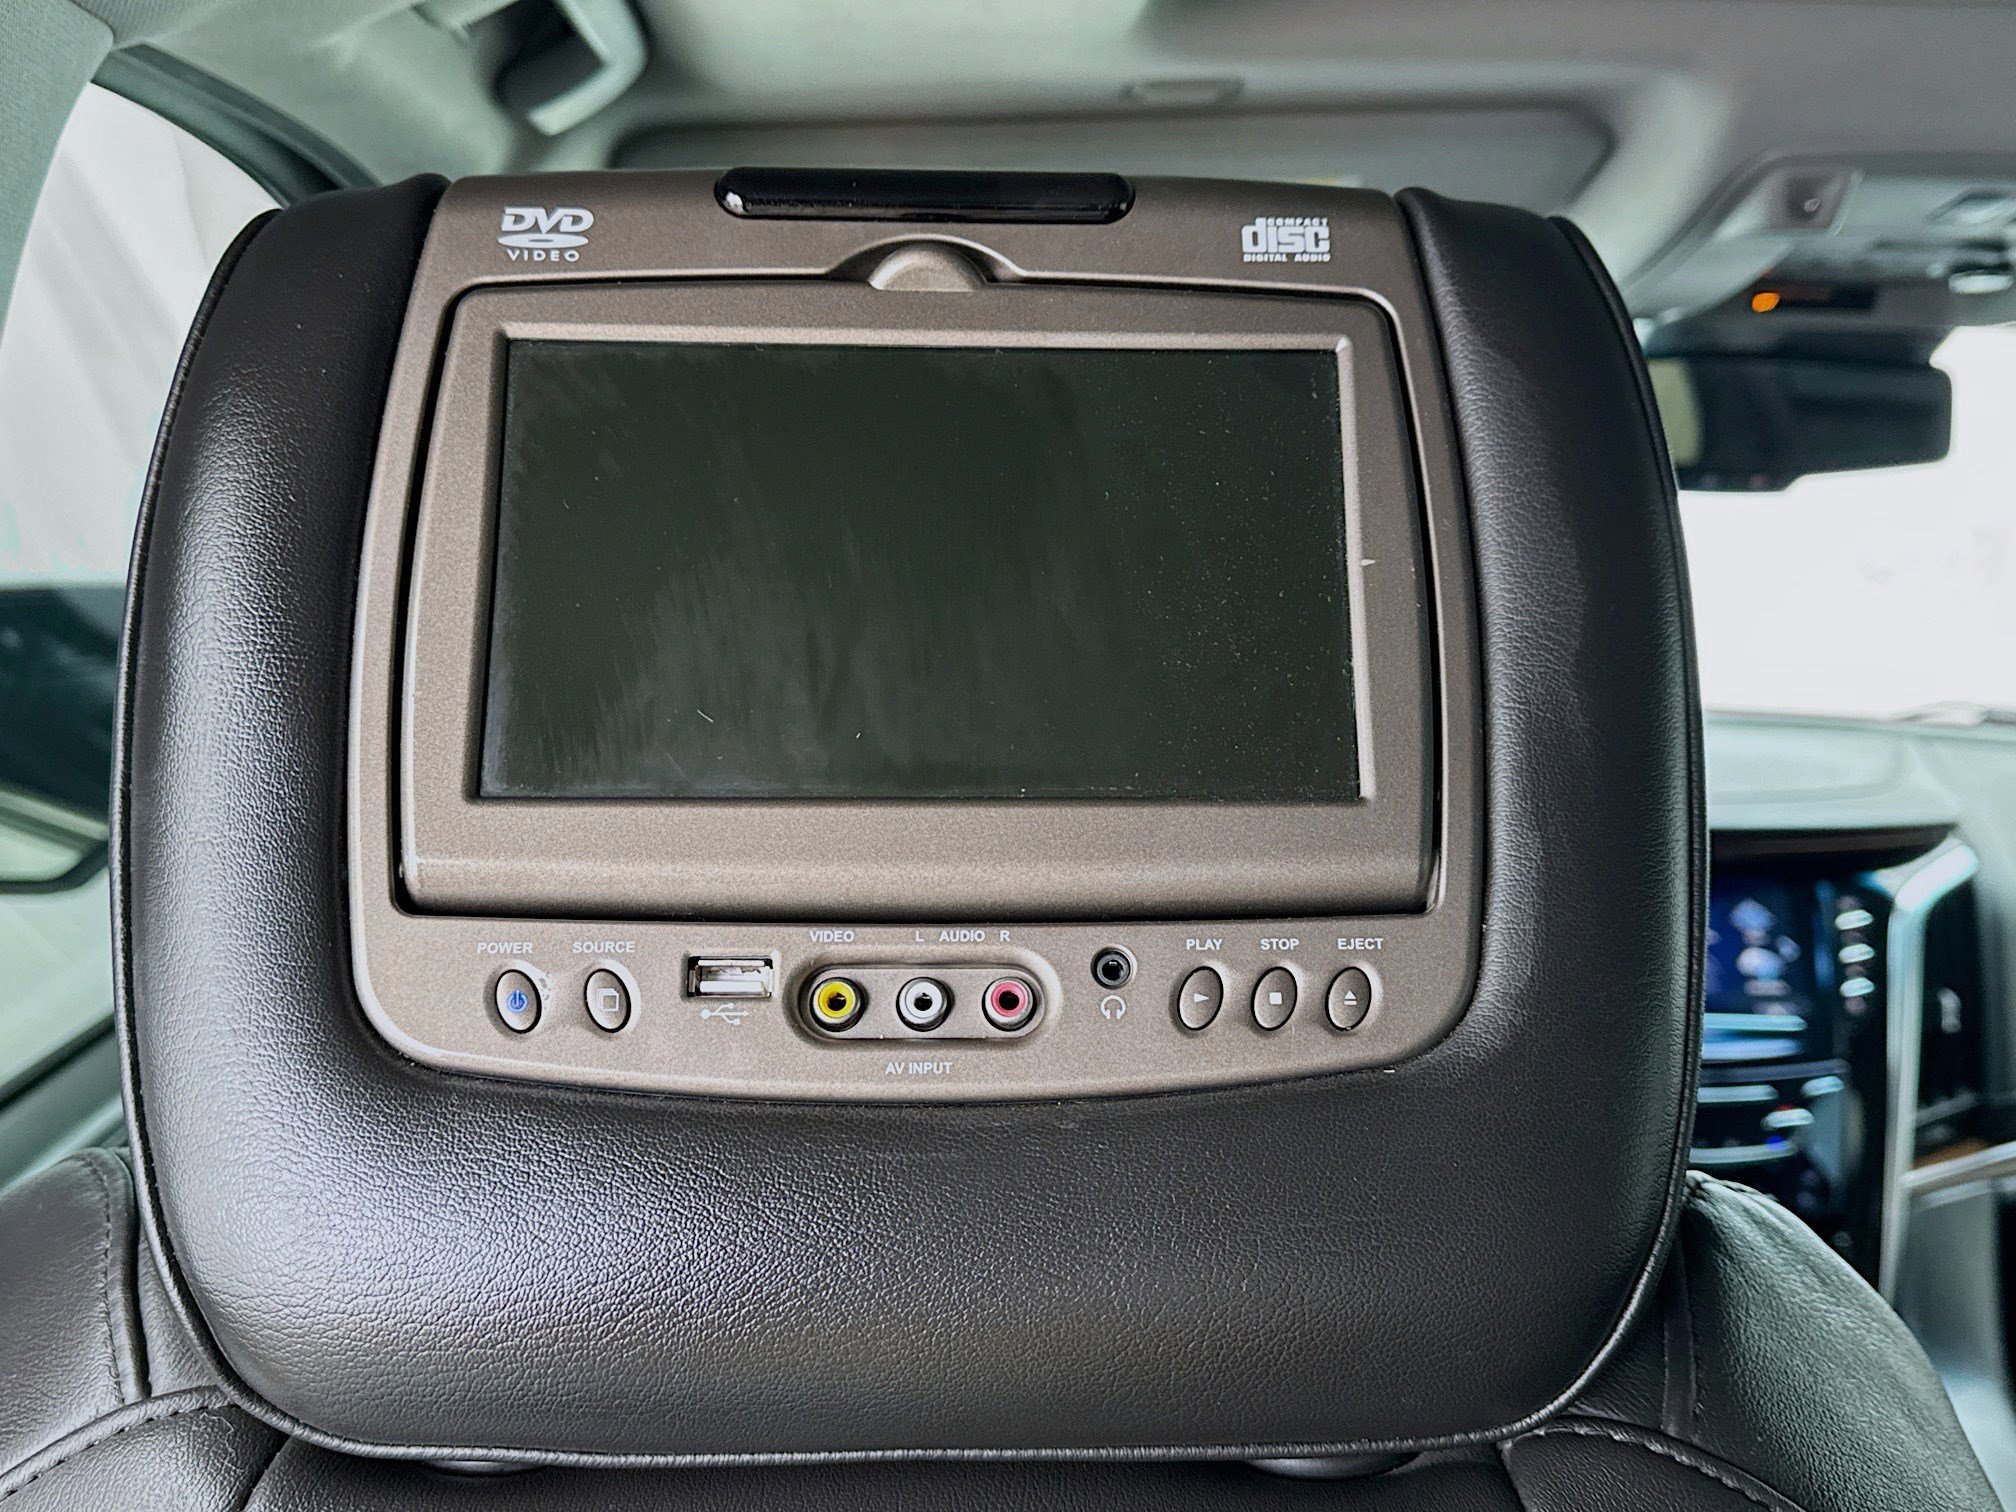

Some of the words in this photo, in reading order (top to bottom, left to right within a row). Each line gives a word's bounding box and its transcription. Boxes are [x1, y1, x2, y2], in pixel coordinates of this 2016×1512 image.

[501, 206, 594, 234] DVD
[1241, 217, 1331, 253] disc
[505, 249, 580, 262] VIDEO
[809, 930, 855, 943] VIDEO
[915, 930, 925, 943] L
[939, 929, 986, 943] AUDIO
[1000, 929, 1011, 943] R
[477, 941, 533, 954] POWER
[572, 940, 636, 954] SOURCE
[1186, 938, 1223, 951] PLAY
[1260, 938, 1300, 951] STOP
[1337, 937, 1384, 951] EJECT
[885, 1062, 905, 1075] AV
[908, 1062, 953, 1075] INPUT
